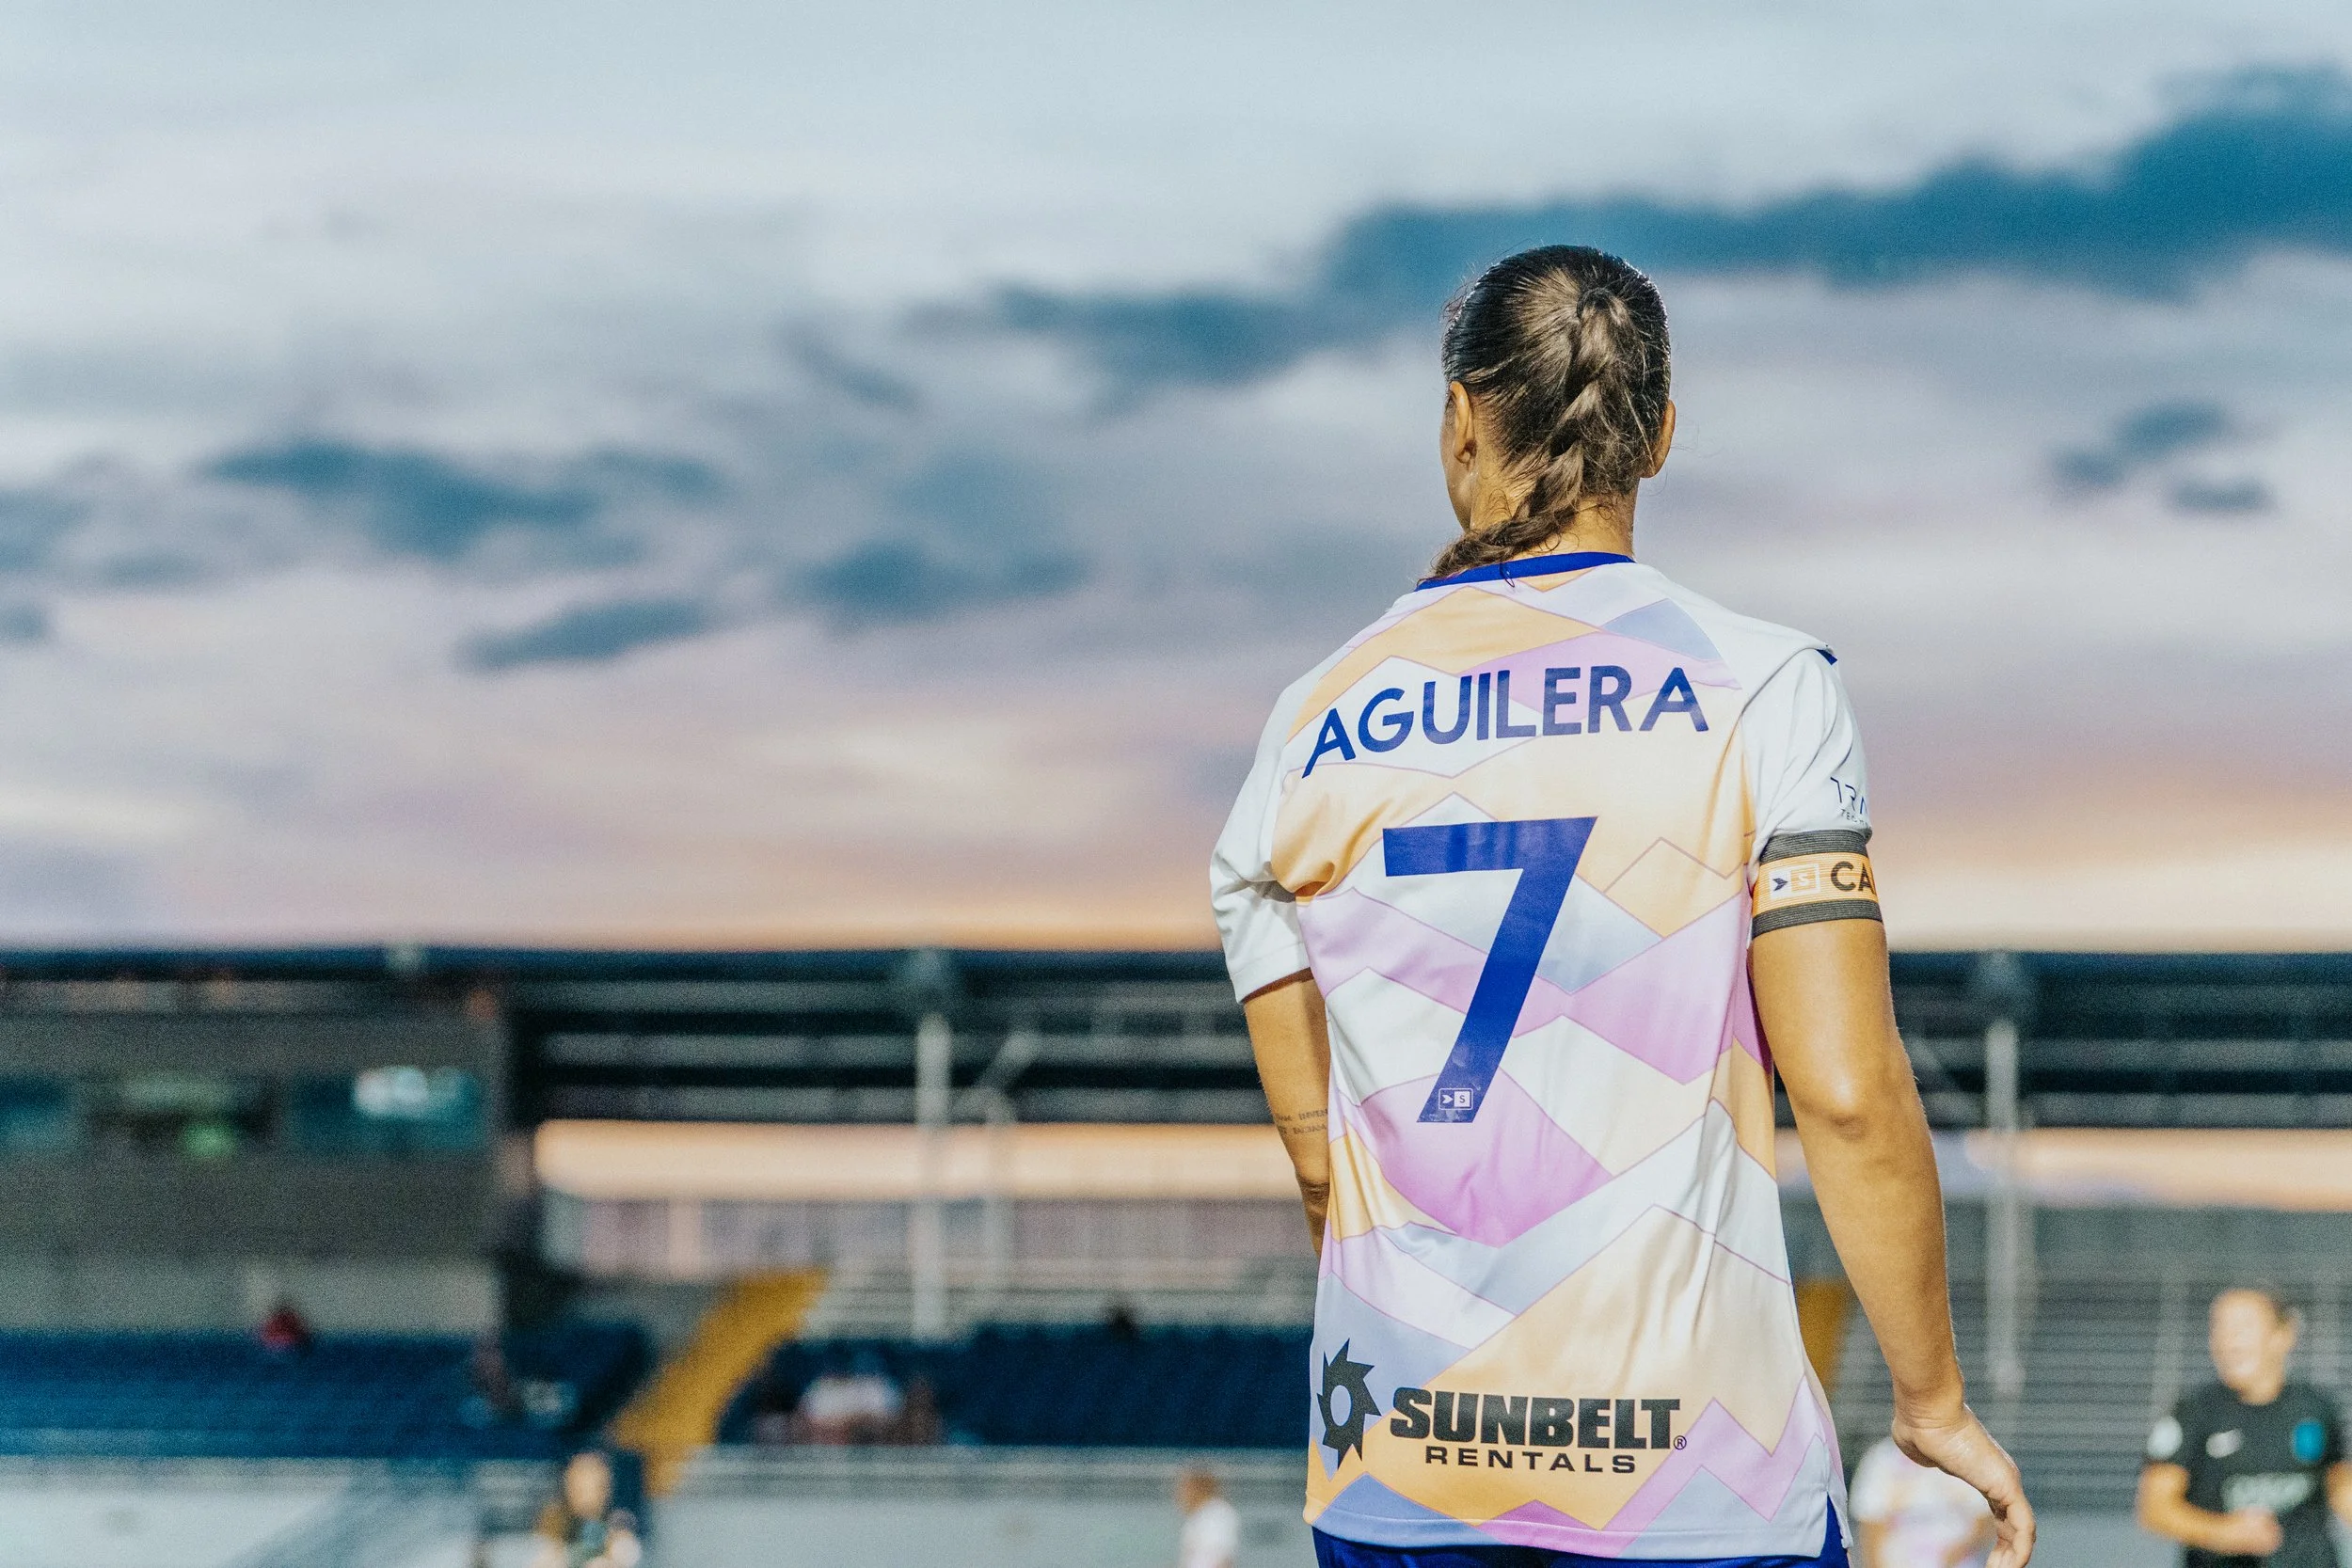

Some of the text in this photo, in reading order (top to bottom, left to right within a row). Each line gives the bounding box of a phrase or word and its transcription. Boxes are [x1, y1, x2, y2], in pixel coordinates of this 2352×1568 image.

[1301, 665, 1709, 779] AGUILERA
[1382, 816, 1599, 1123] 7
[1459, 1094, 1466, 1103] S
[1424, 1446, 1636, 1474] RENTALS
